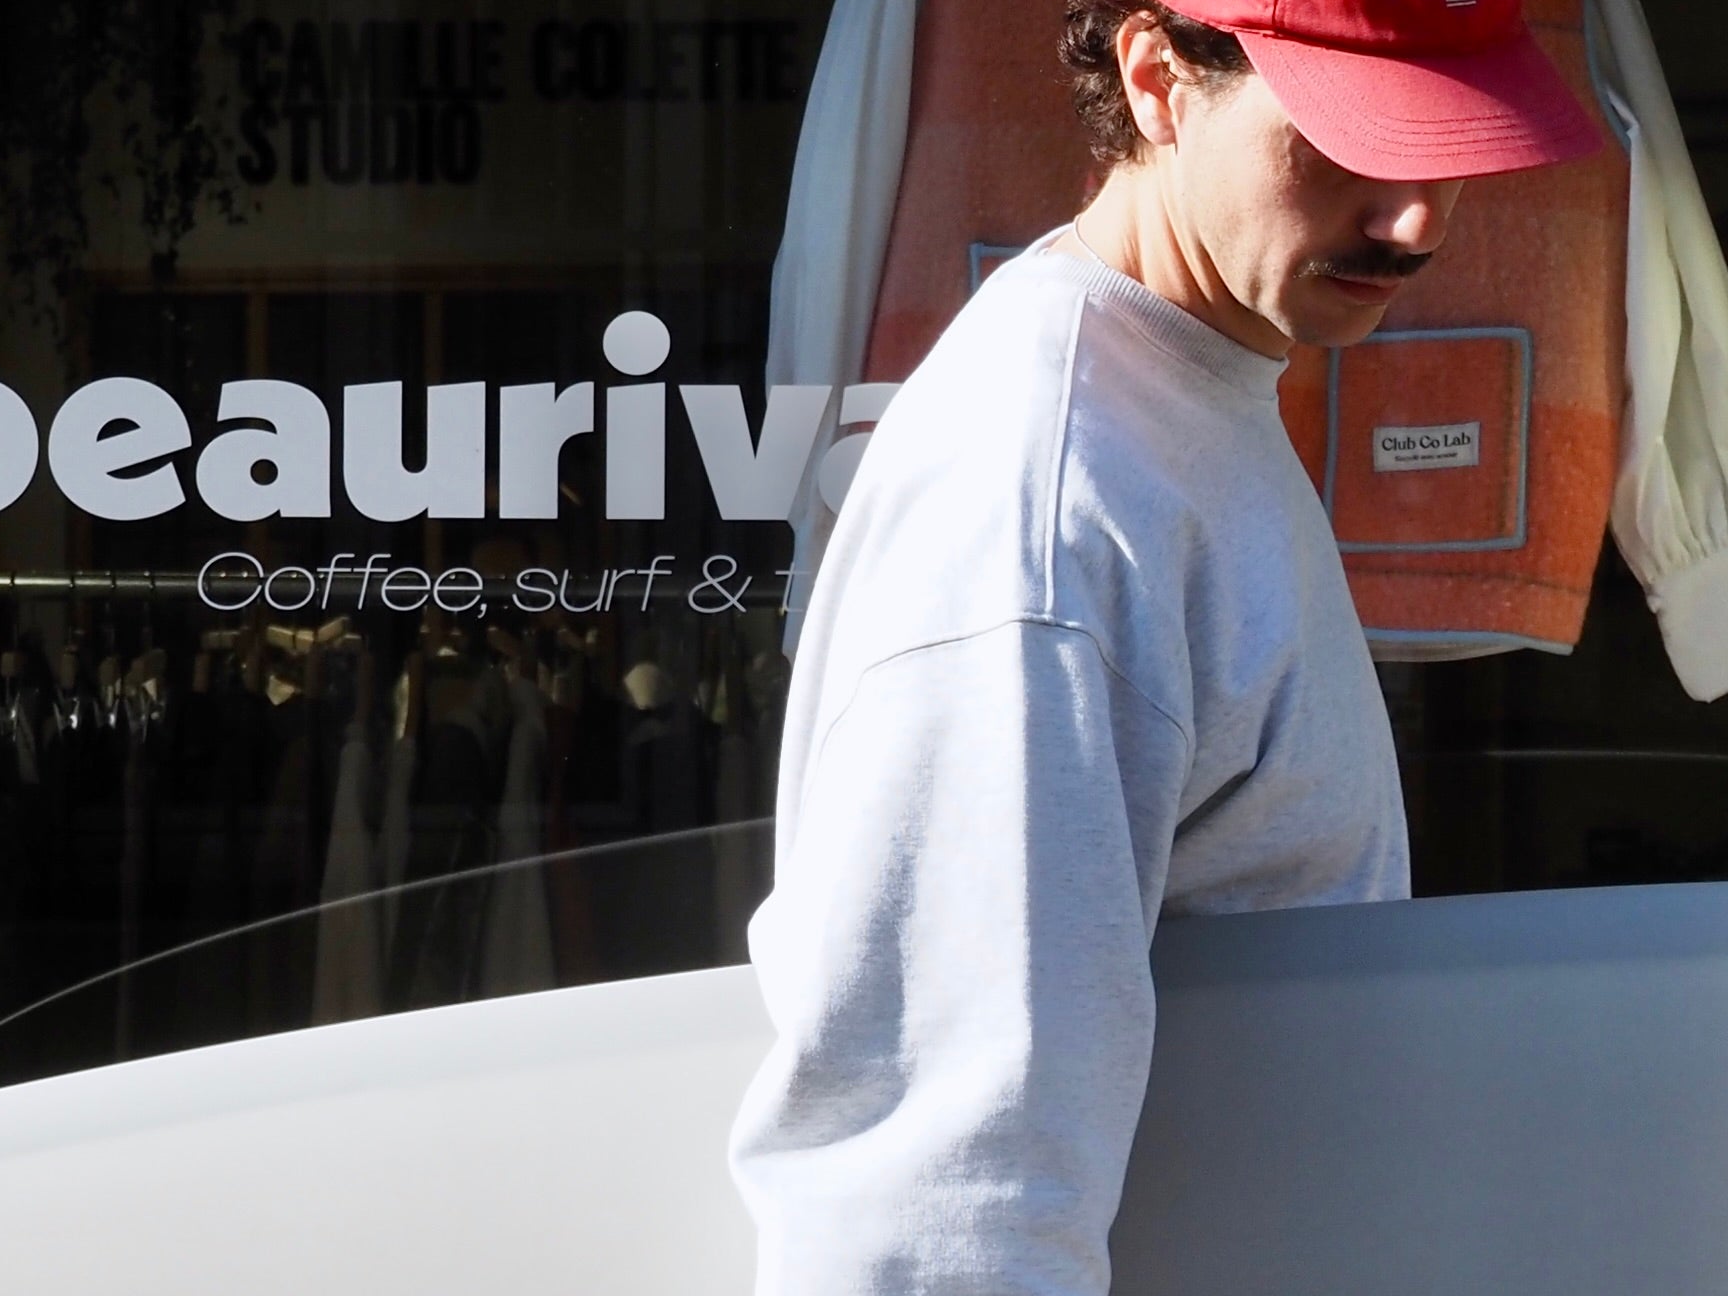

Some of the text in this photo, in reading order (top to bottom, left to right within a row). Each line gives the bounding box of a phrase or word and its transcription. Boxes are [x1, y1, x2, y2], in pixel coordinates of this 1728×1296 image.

[245, 20, 800, 101] CAMILLE COLETTE
[238, 103, 481, 185] STUDIO
[1381, 431, 1472, 452] Club Co Lab
[198, 552, 487, 619] Coffee,
[513, 555, 675, 612] surf
[688, 554, 752, 613] &
